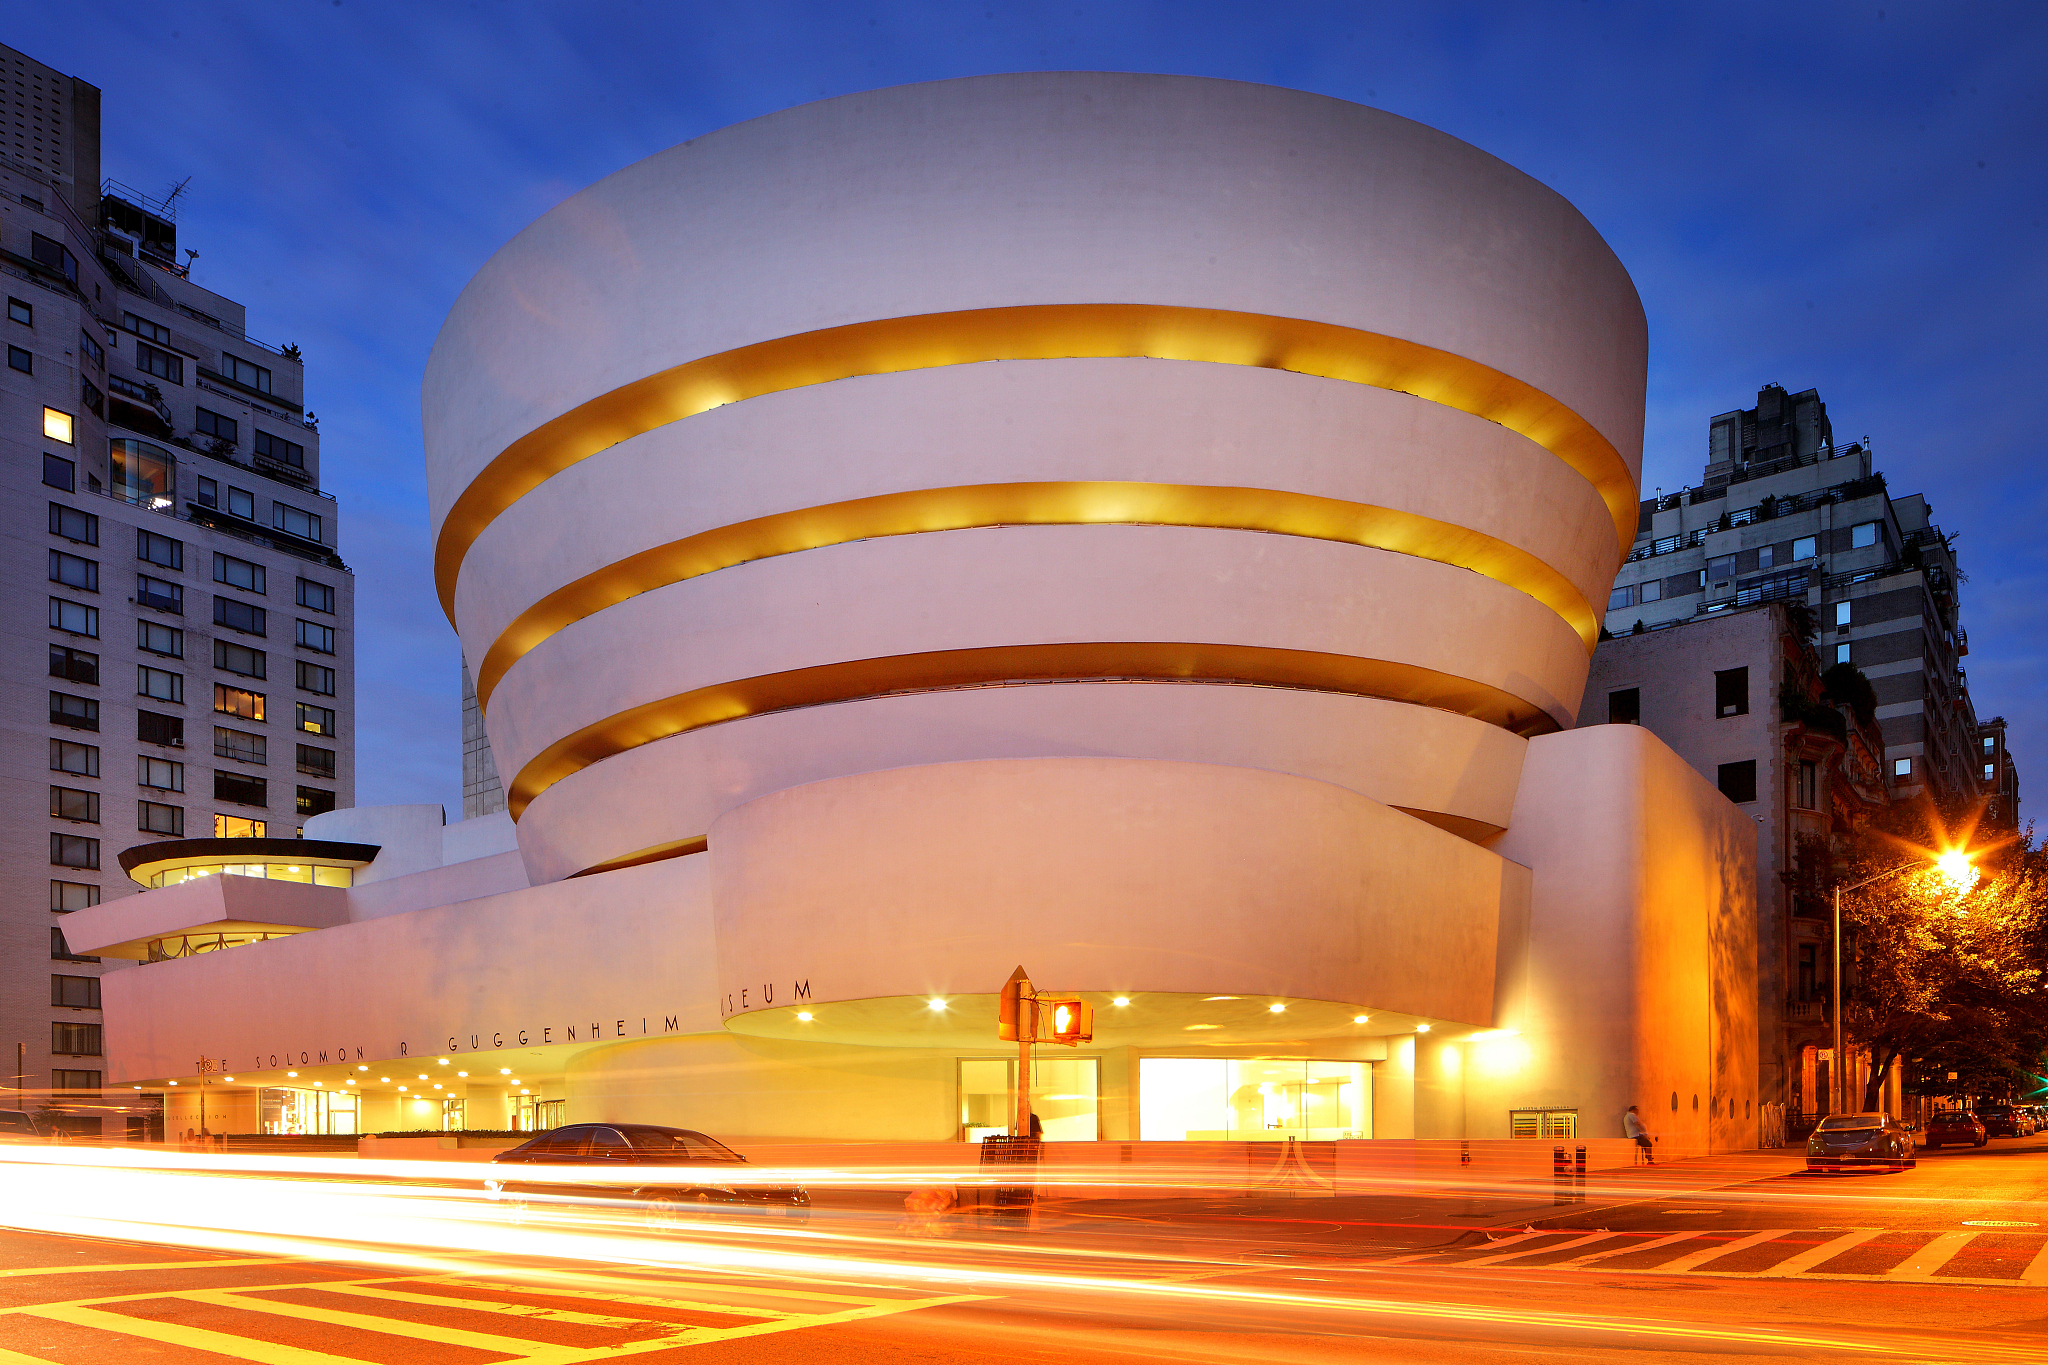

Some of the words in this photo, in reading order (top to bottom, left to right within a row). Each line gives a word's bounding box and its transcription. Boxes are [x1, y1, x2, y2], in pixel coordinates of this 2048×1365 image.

[195, 1059, 228, 1074] TE
[255, 1046, 364, 1069] SOLOMON
[400, 1041, 408, 1057] R
[448, 1014, 679, 1052] GUGGENHEIM
[720, 978, 812, 1017] USEUM
